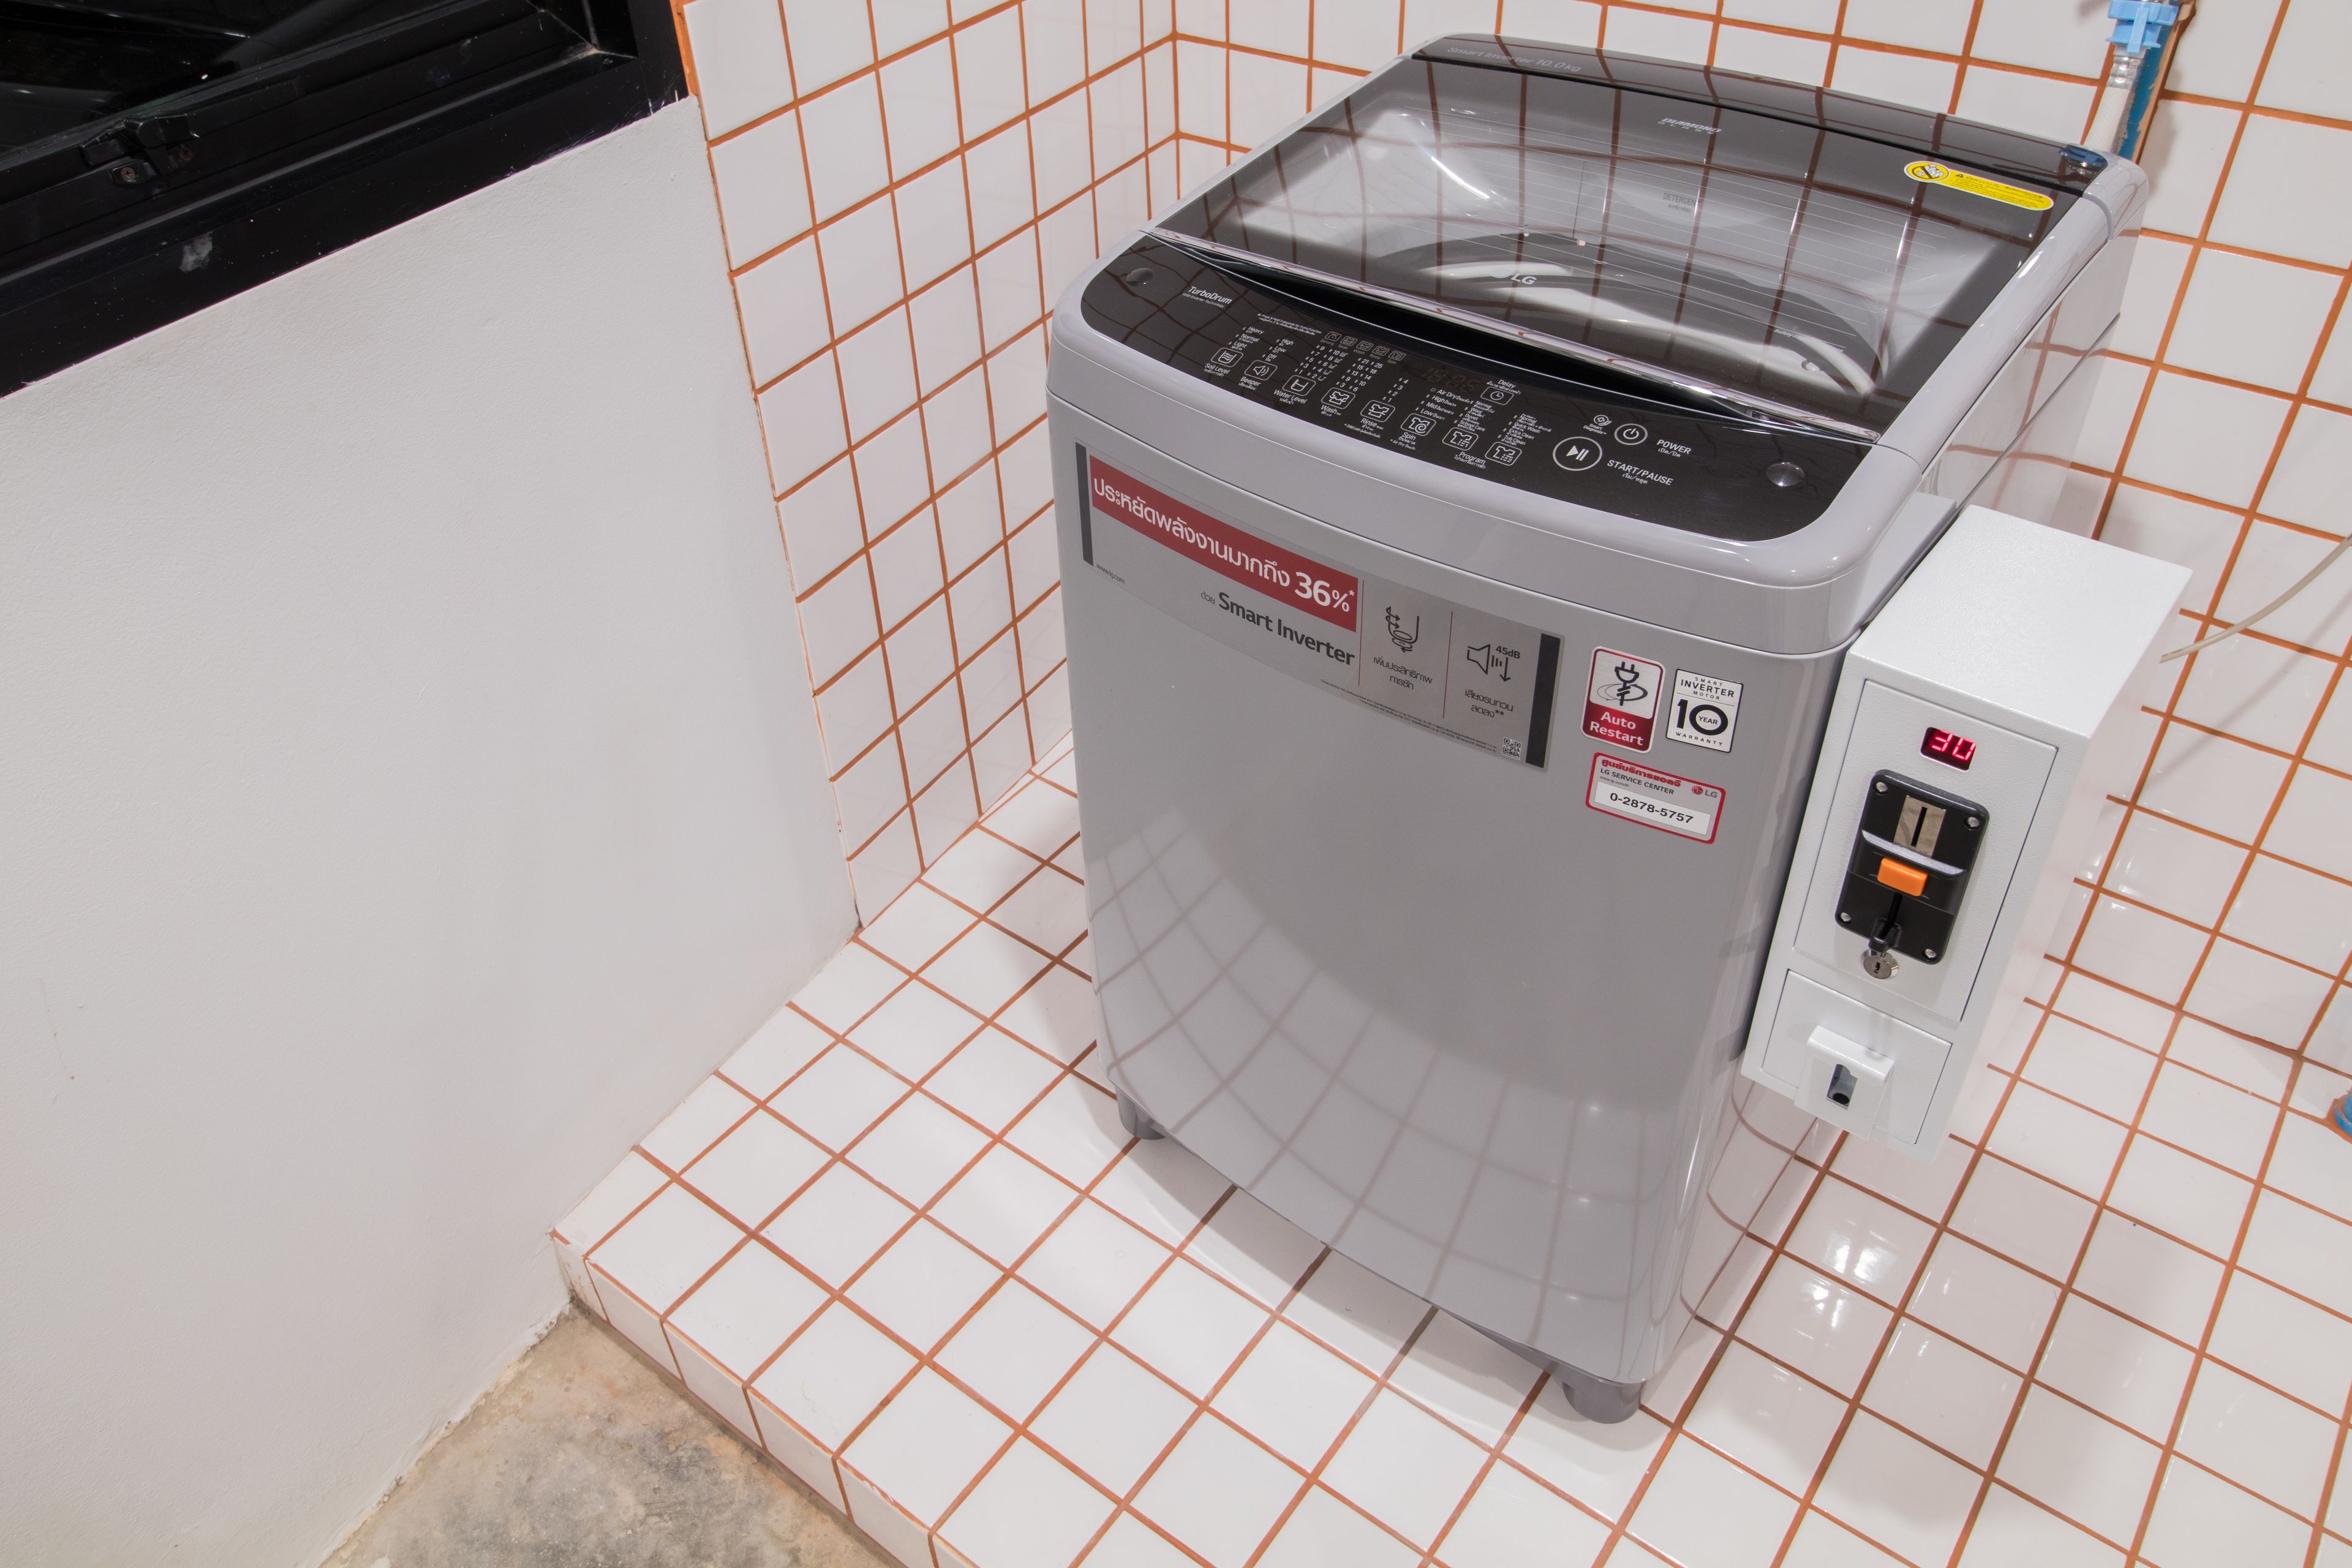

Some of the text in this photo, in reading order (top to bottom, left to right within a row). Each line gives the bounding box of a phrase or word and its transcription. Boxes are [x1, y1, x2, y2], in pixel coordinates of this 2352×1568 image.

[1447, 47, 1485, 57] Smart
[1485, 52, 1534, 63] Inverter
[1660, 118, 1722, 132] DIAMOND
[1663, 192, 1700, 206] DETERGEN
[1510, 273, 1537, 284] LG
[1188, 286, 1232, 304] TurboDrum
[1241, 333, 1260, 342] Normal
[1248, 326, 1264, 335] Heavy
[1215, 365, 1230, 374] Level
[1240, 376, 1261, 386] Beeper
[1498, 379, 1517, 388] Delay
[1274, 390, 1308, 404] Water Level
[1432, 395, 1445, 404] High
[1321, 405, 1338, 415] Wash
[1361, 418, 1377, 428] Rinse
[1402, 432, 1416, 440] Spin
[1657, 439, 1691, 454] POWER
[1658, 447, 1681, 458] เปิด/ปิด
[1459, 451, 1486, 465] Program
[1607, 460, 1674, 486] START/PAUSE
[1094, 478, 1291, 587] ประหยัดพลังงานมากถึง
[1096, 563, 1126, 585] www.lg.com
[1200, 591, 1355, 666] ด้วย Smart Inverter
[1495, 646, 1521, 659] 45dB
[1373, 656, 1433, 684] เพิ่มประสิทธิภาพ
[1389, 675, 1414, 690] การซัก
[1680, 679, 1735, 698] INVERTER
[1695, 677, 1724, 687] SMART
[1464, 689, 1513, 712] เสียงรบกวน
[1693, 690, 1721, 700] MOTOR
[1600, 710, 1637, 730] Auto
[1676, 698, 1728, 736] 10 YEAR
[1589, 720, 1644, 747] Restart
[1675, 731, 1724, 747] WARRANTY
[1601, 758, 1682, 788] ศูนย์บริการแอลจี
[1600, 767, 1675, 795] LG SERVICE CENTER
[1705, 790, 1718, 799] LG
[1610, 792, 1694, 824] 0-2878-5757
